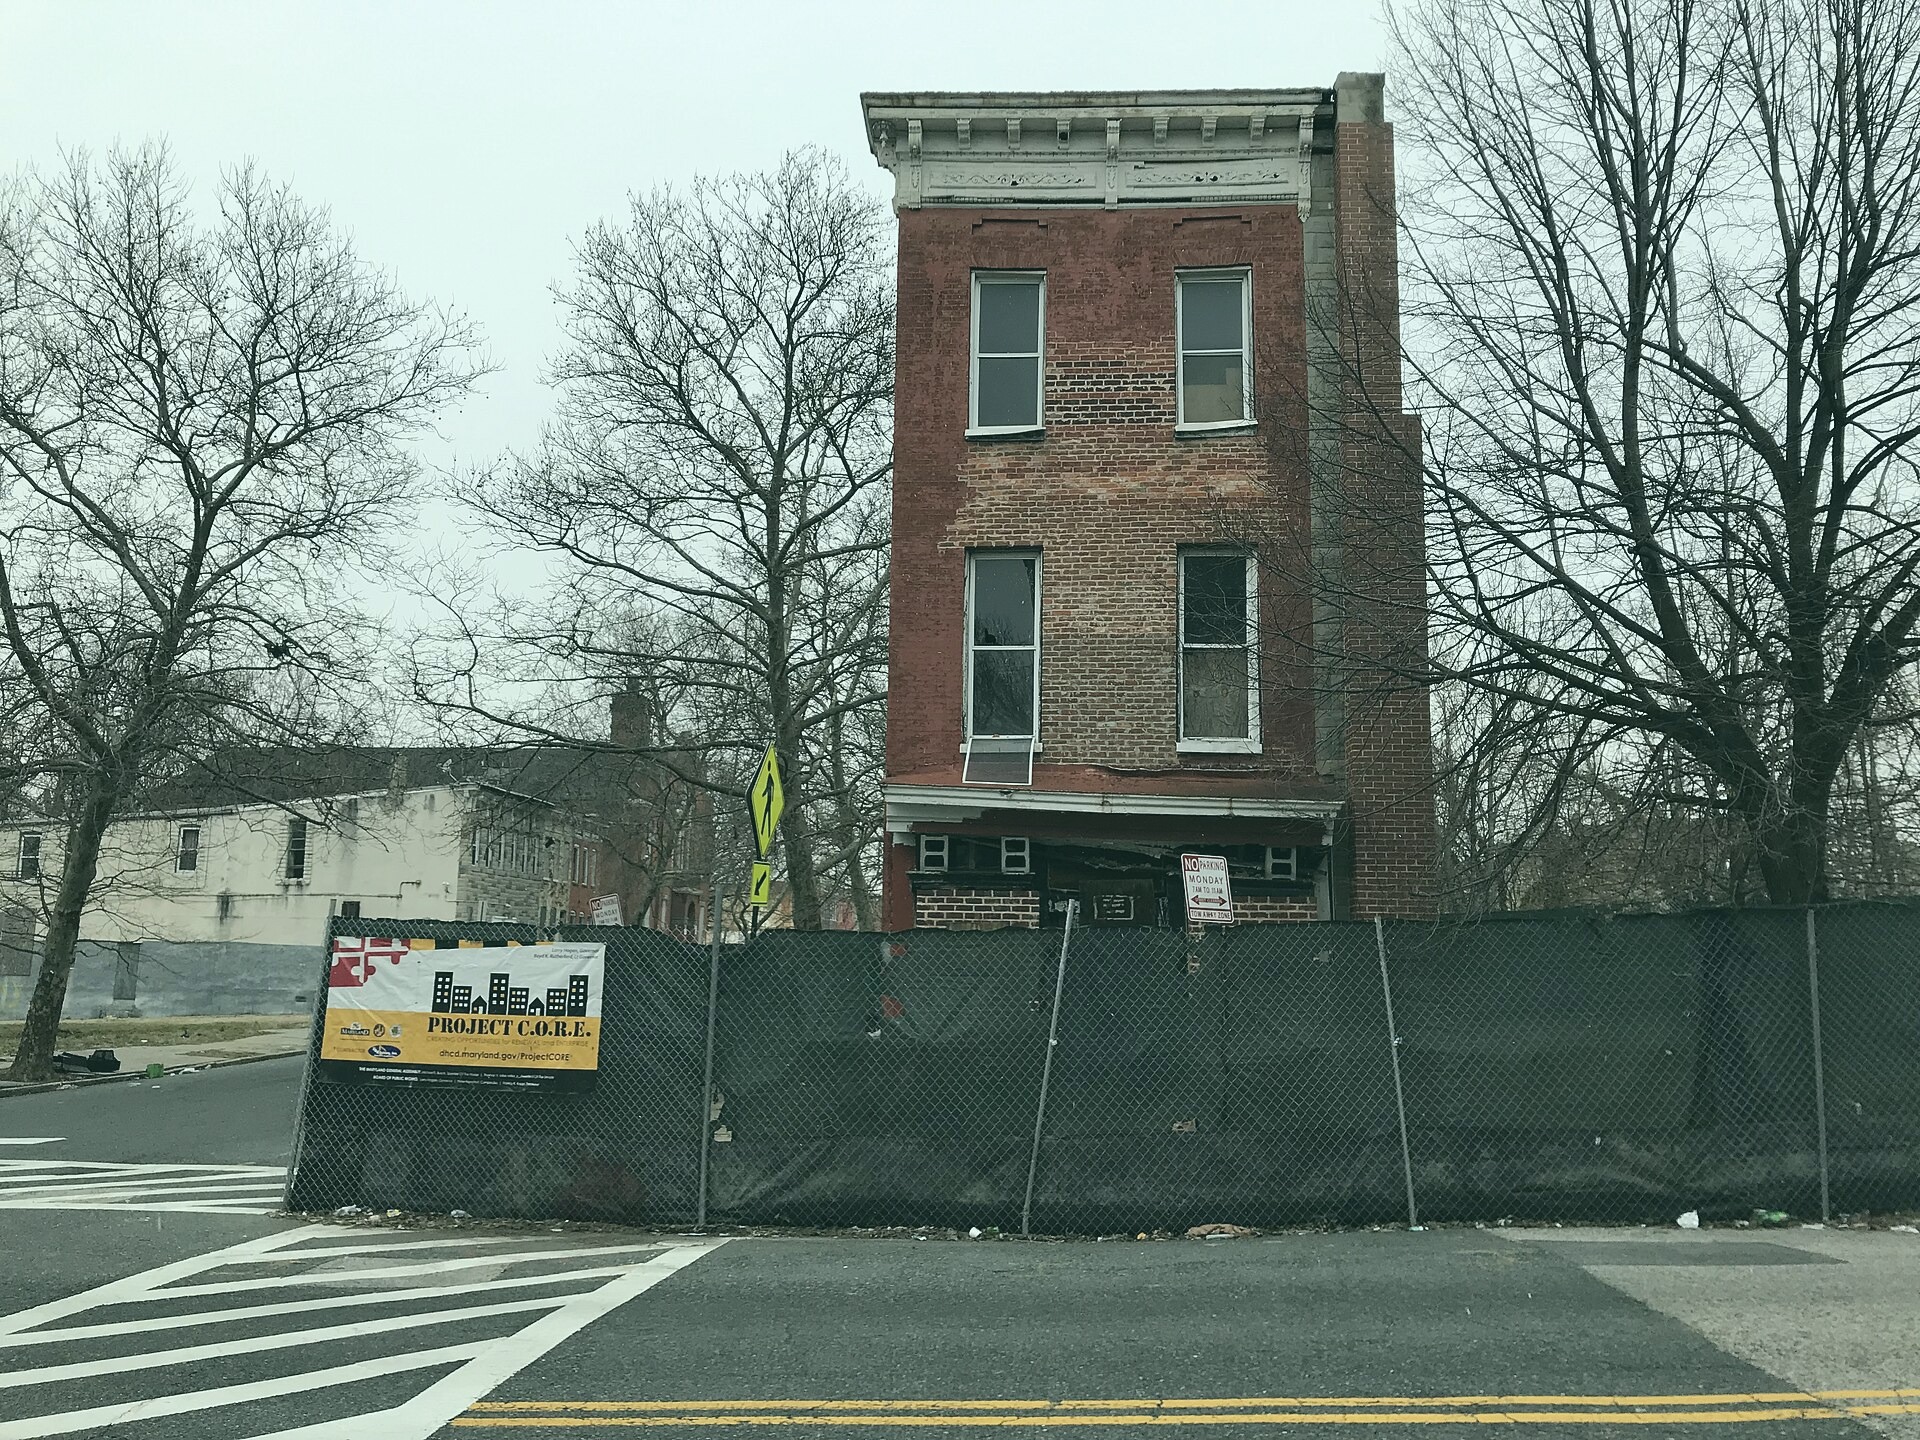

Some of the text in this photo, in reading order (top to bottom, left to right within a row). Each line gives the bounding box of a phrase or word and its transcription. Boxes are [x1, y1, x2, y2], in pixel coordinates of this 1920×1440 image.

[1184, 858, 1224, 871] NO PARKING
[1189, 875, 1223, 884] MONDAY
[591, 900, 602, 910] NO
[427, 1017, 591, 1037] PROJECT C.O.R.E.
